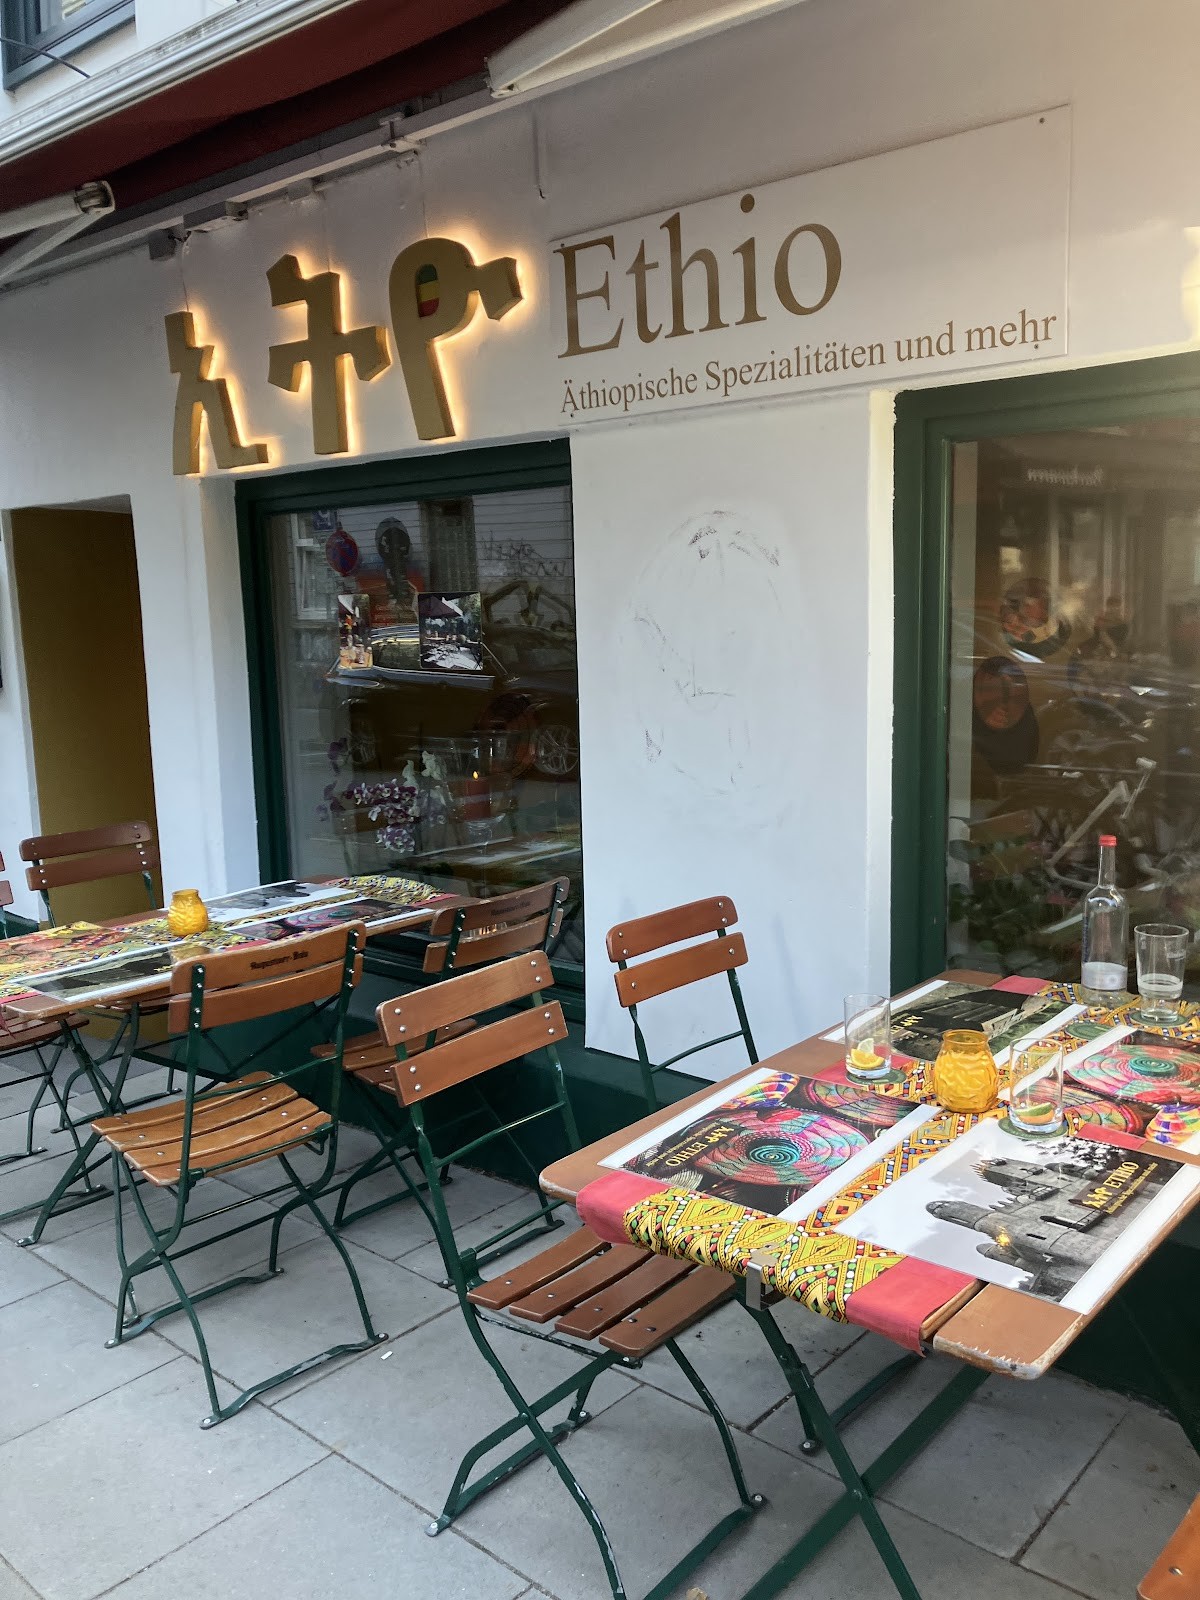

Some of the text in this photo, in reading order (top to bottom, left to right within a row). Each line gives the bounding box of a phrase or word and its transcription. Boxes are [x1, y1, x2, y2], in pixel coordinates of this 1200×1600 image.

[553, 193, 843, 359] Ethio
[560, 308, 1057, 413] Äthiopische Spezialitäten und mehr
[665, 1141, 709, 1167] ETHIO
[1103, 1161, 1140, 1189] ETHIO
